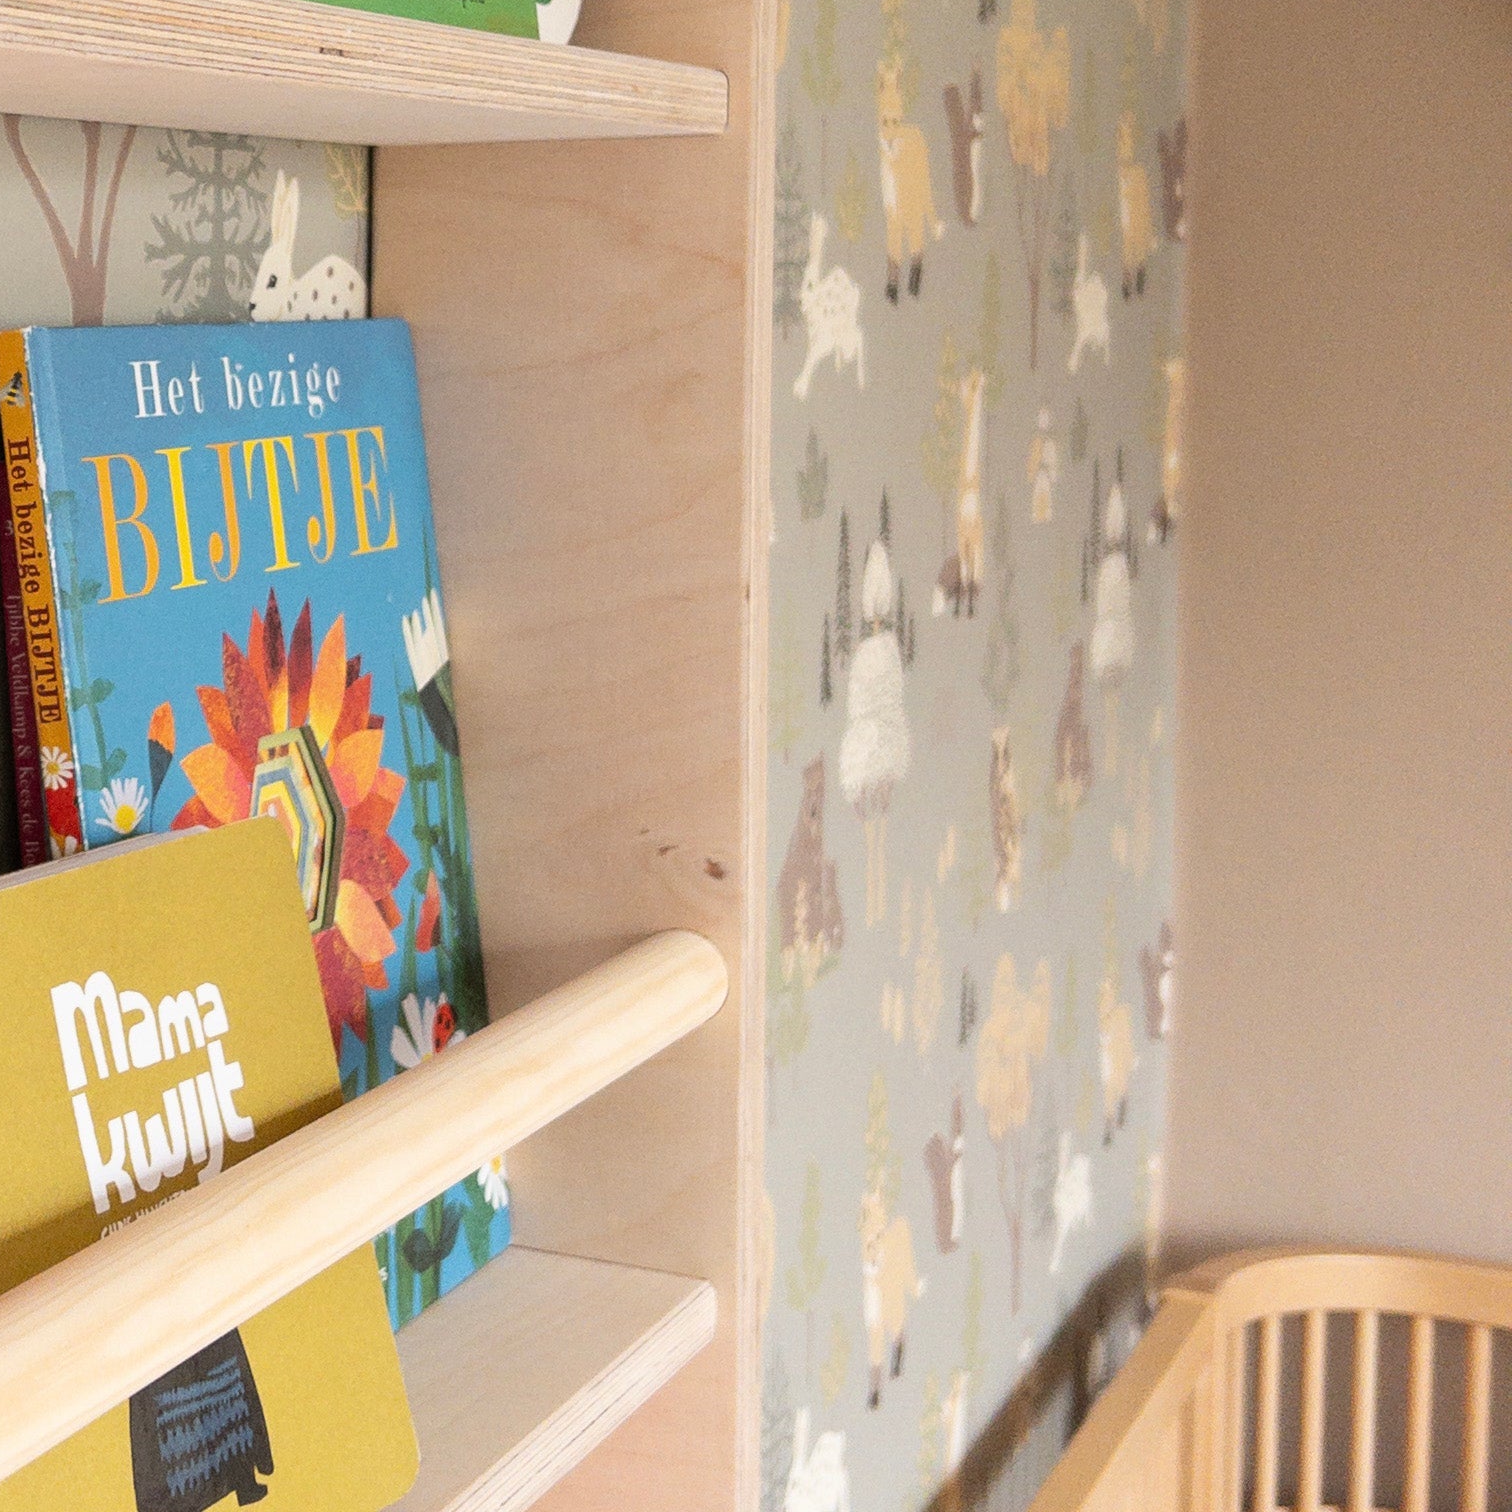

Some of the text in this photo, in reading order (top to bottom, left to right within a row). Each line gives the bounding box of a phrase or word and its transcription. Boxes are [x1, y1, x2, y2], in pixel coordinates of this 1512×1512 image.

[128, 352, 342, 419] Het bezige
[7, 436, 62, 724] Het bezige BIJTJE
[80, 425, 399, 604] BIJTJE
[10, 651, 30, 739] Veldkamp
[50, 970, 229, 1092] Mama
[71, 1039, 256, 1215] kwijt
